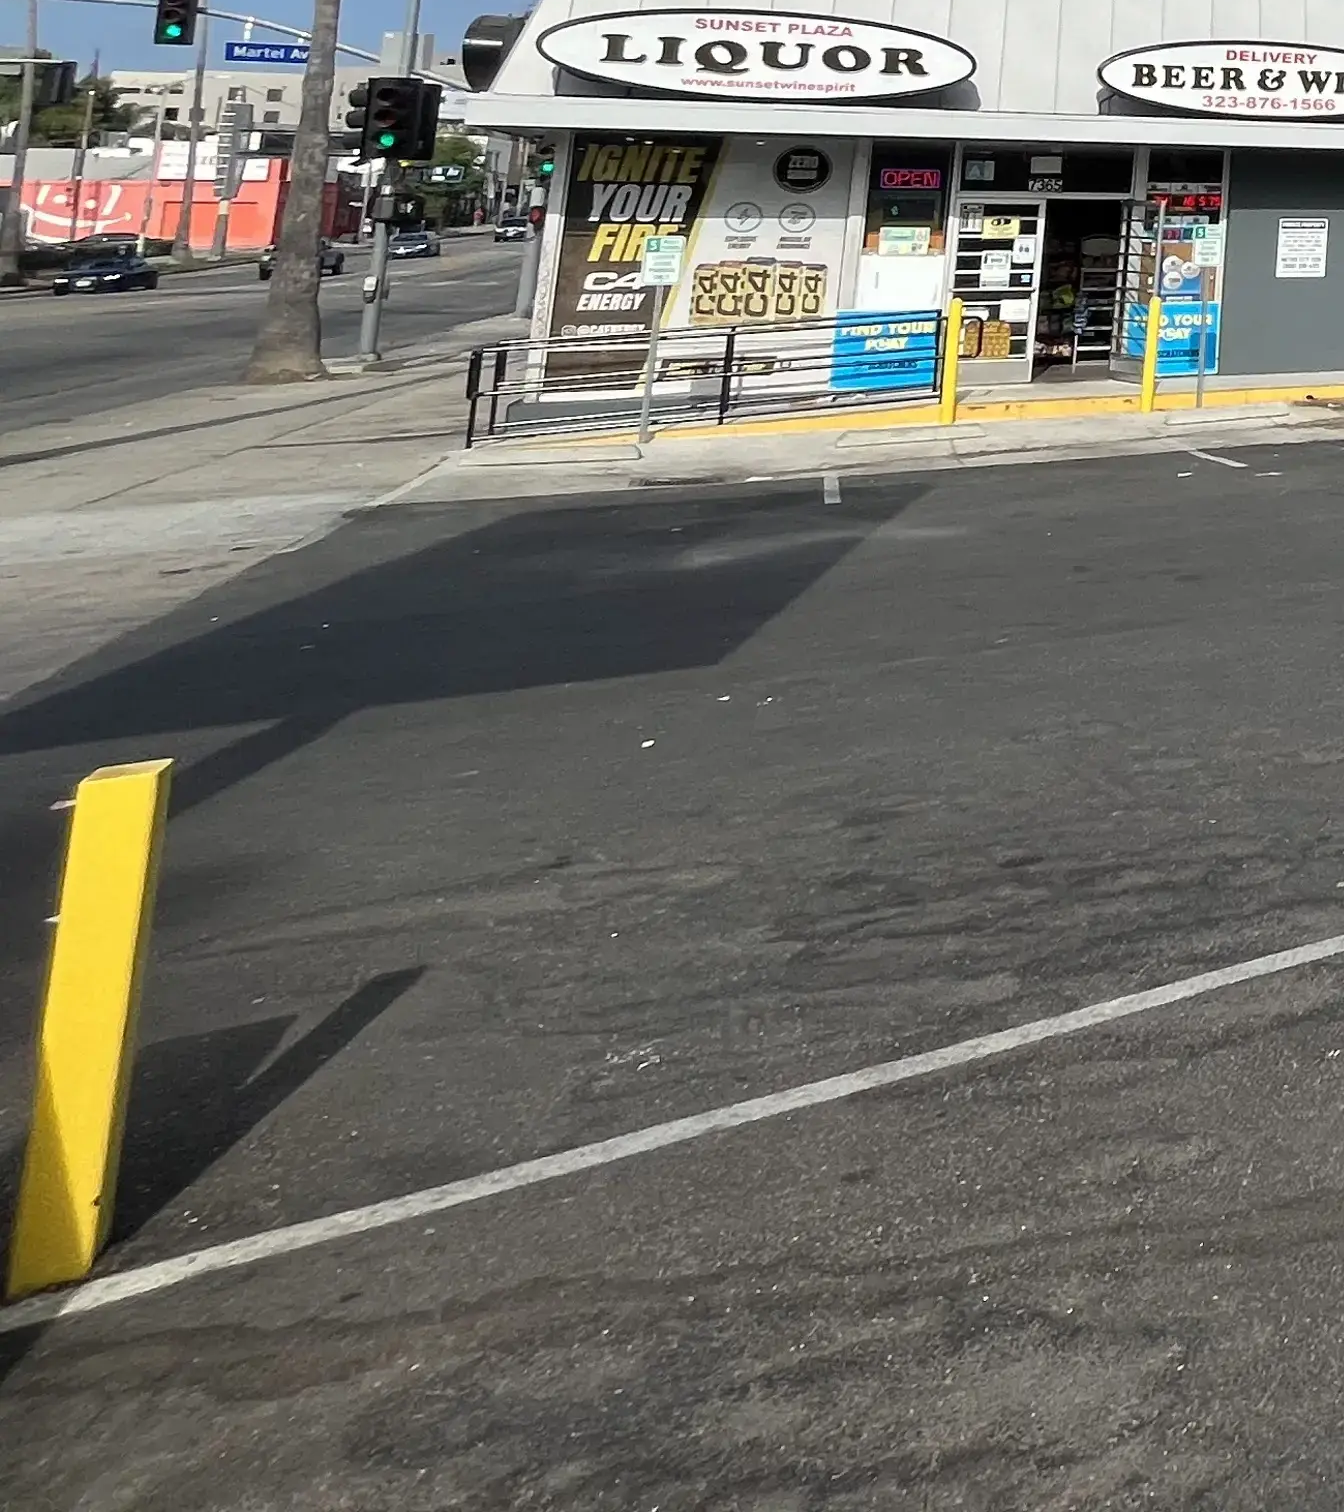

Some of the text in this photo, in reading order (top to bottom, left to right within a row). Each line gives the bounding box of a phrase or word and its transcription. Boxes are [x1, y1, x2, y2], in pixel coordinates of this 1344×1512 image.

[695, 17, 853, 38] SUNSET PLAZA
[233, 45, 285, 59] Martel
[600, 33, 930, 76] LIQUOR
[1226, 50, 1318, 65] DELIVERY
[681, 77, 856, 93] www.sunsetwinespirit
[1131, 63, 1247, 91] BEER
[1257, 65, 1287, 90] &
[1201, 94, 1337, 112] 323-876-1566
[577, 144, 706, 183] IGNITE
[882, 170, 938, 187] OPEN
[587, 184, 693, 222] YOUR
[583, 272, 646, 291] C4
[576, 293, 646, 312] ENERGY
[744, 269, 771, 317] C4
